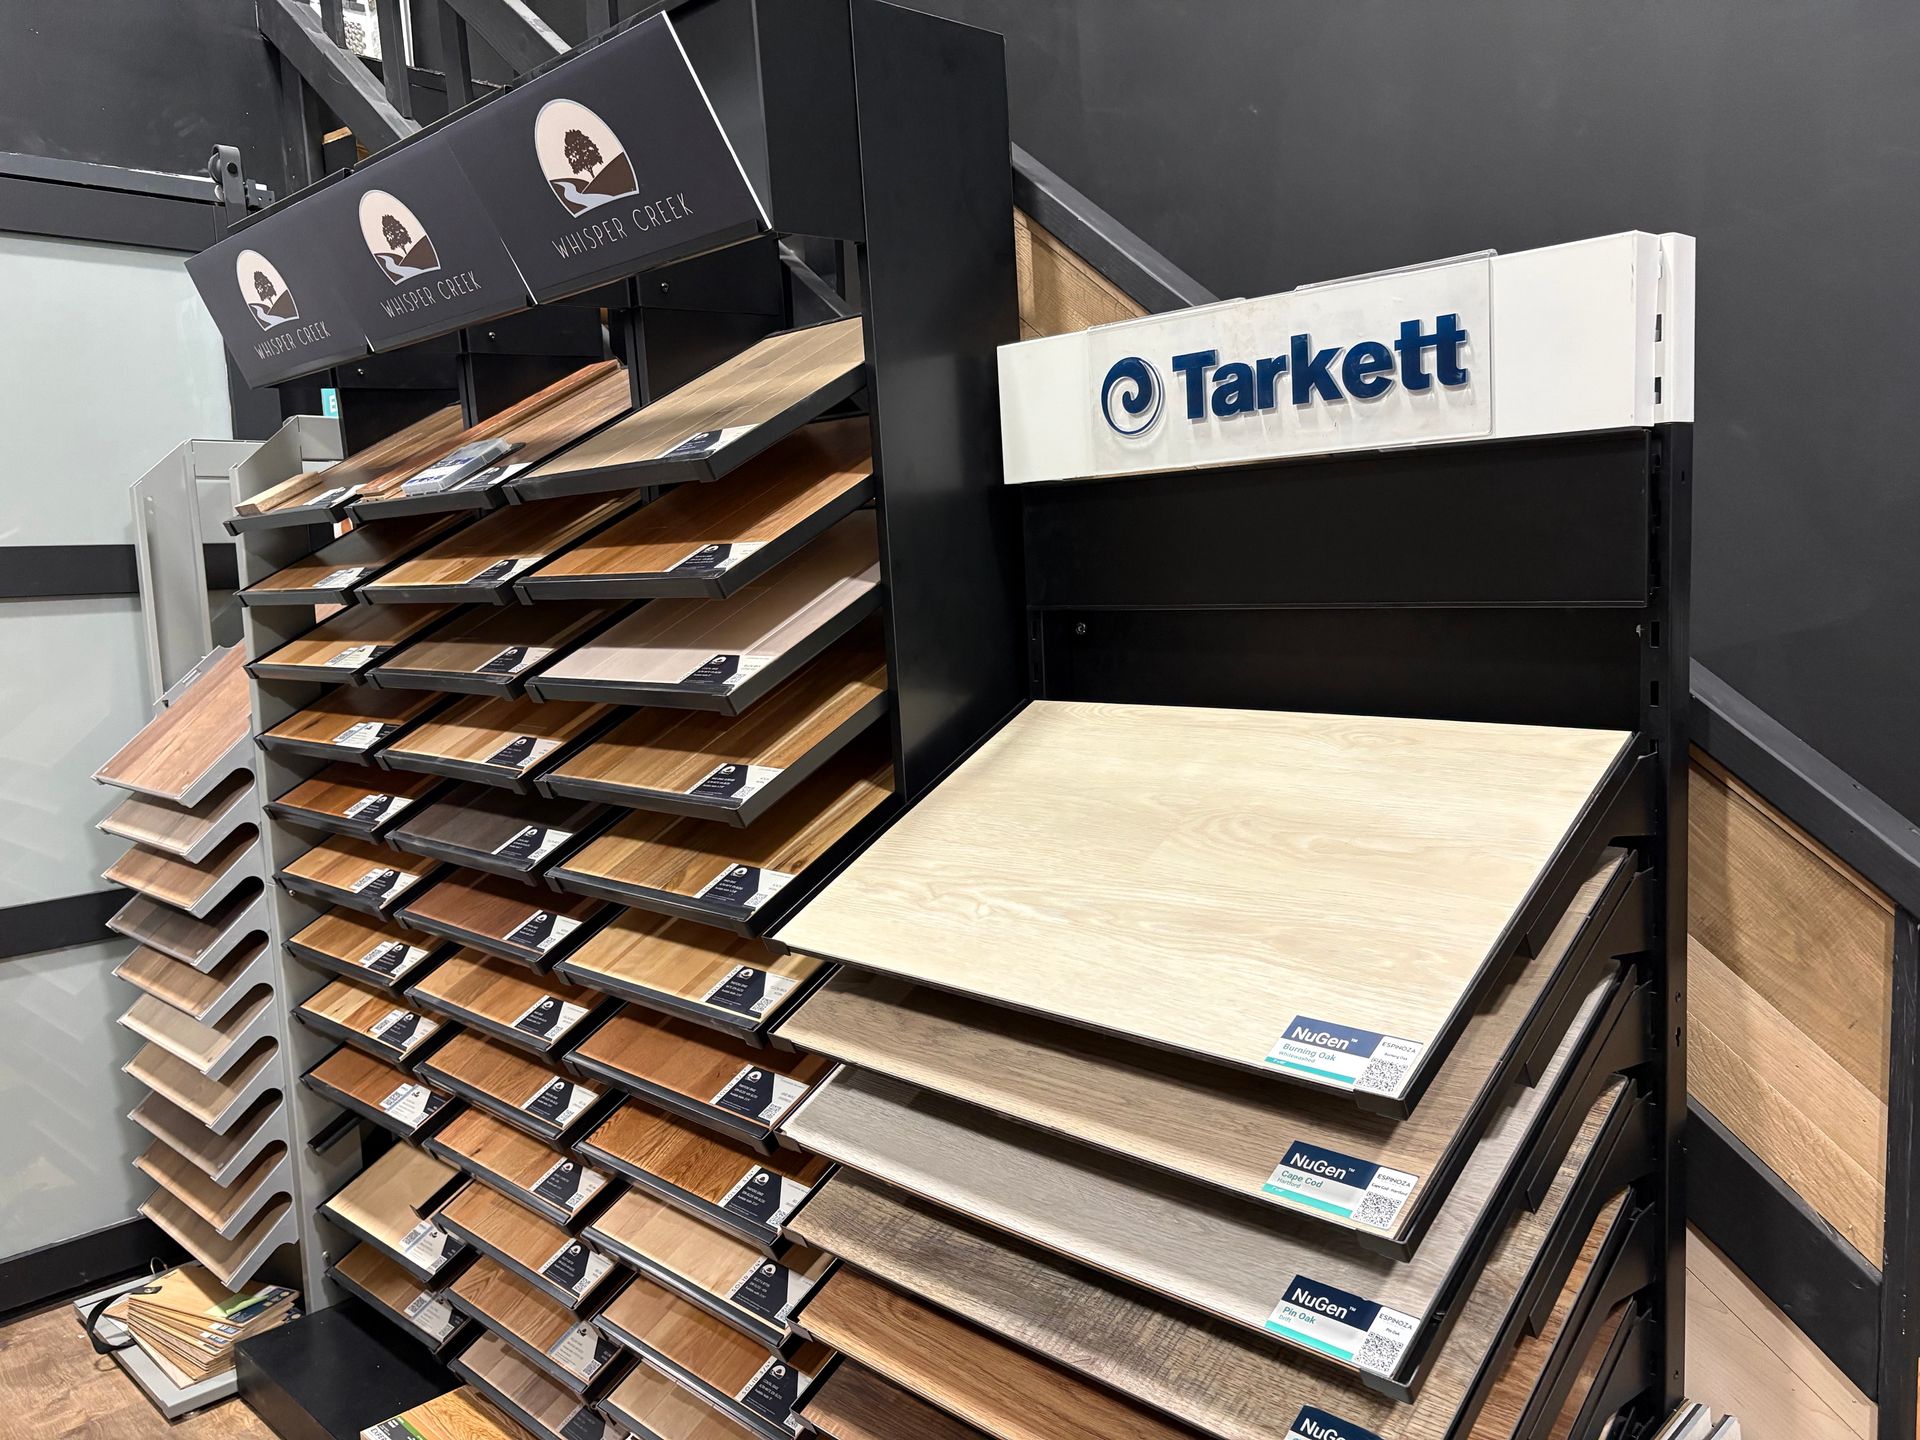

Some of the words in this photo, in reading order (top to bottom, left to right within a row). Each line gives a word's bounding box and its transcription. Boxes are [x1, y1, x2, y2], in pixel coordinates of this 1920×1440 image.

[551, 217, 628, 259] WHISPER
[632, 192, 694, 231] CREEK
[380, 286, 436, 318] WHISPER
[437, 270, 482, 300] CREEK
[253, 333, 297, 360] WHISPER
[297, 320, 331, 346] CREEK
[1171, 313, 1470, 420] Tarkett
[1283, 1043, 1317, 1058] Burning
[1318, 1052, 1337, 1062] Oak
[1277, 1177, 1302, 1189] Hartford
[1281, 1170, 1304, 1184] Cape
[1305, 1177, 1323, 1188] Cod
[1377, 1173, 1411, 1188] ESPINOZA
[731, 1275, 749, 1293] SOLID
[1278, 1314, 1292, 1323] Drift
[1282, 1306, 1297, 1318] Pin
[1298, 1312, 1316, 1325] Oak
[1379, 1313, 1413, 1330] ESPINOZA
[741, 1377, 759, 1395] SOLID
